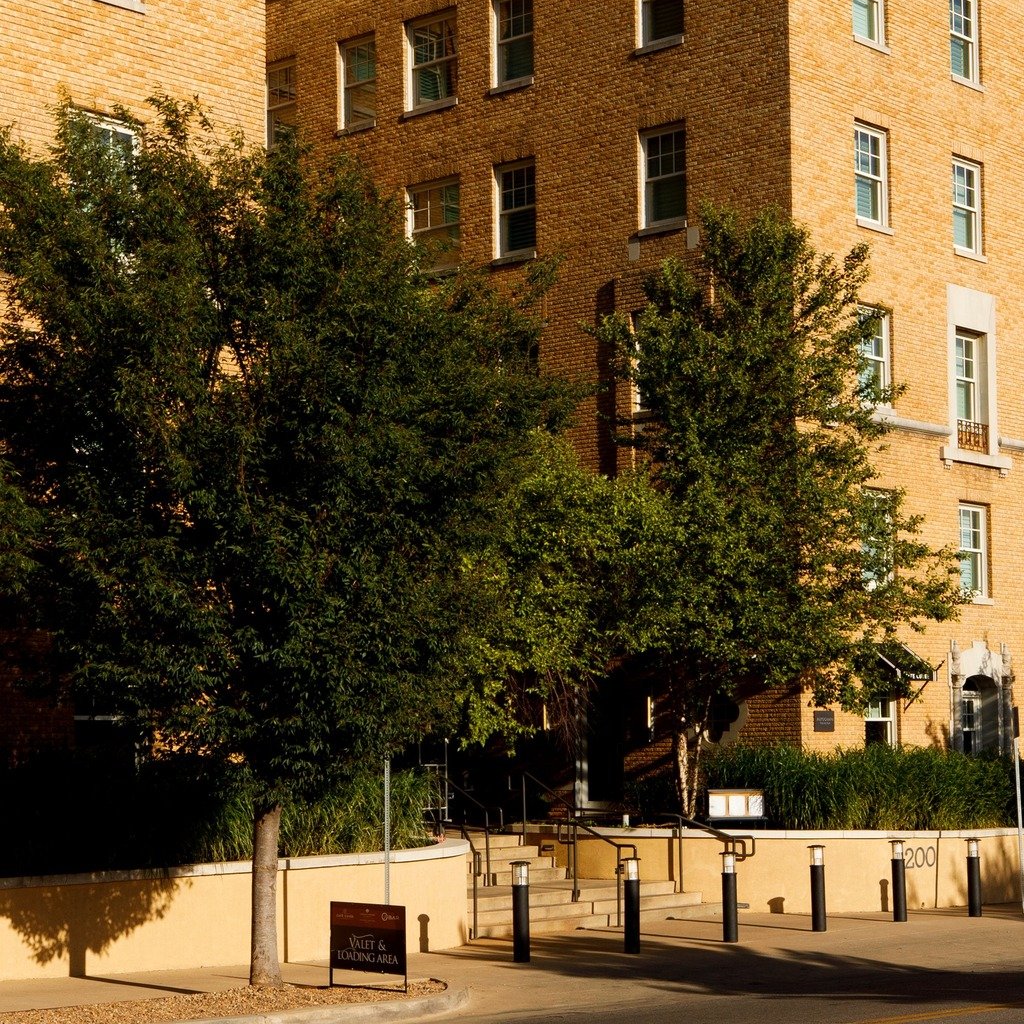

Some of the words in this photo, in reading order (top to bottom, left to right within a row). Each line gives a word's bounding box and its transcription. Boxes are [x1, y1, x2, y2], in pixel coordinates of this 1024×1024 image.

[349, 936, 375, 950] VALET
[377, 939, 387, 951] &
[337, 949, 375, 963] LOADING
[376, 953, 399, 965] AREA
